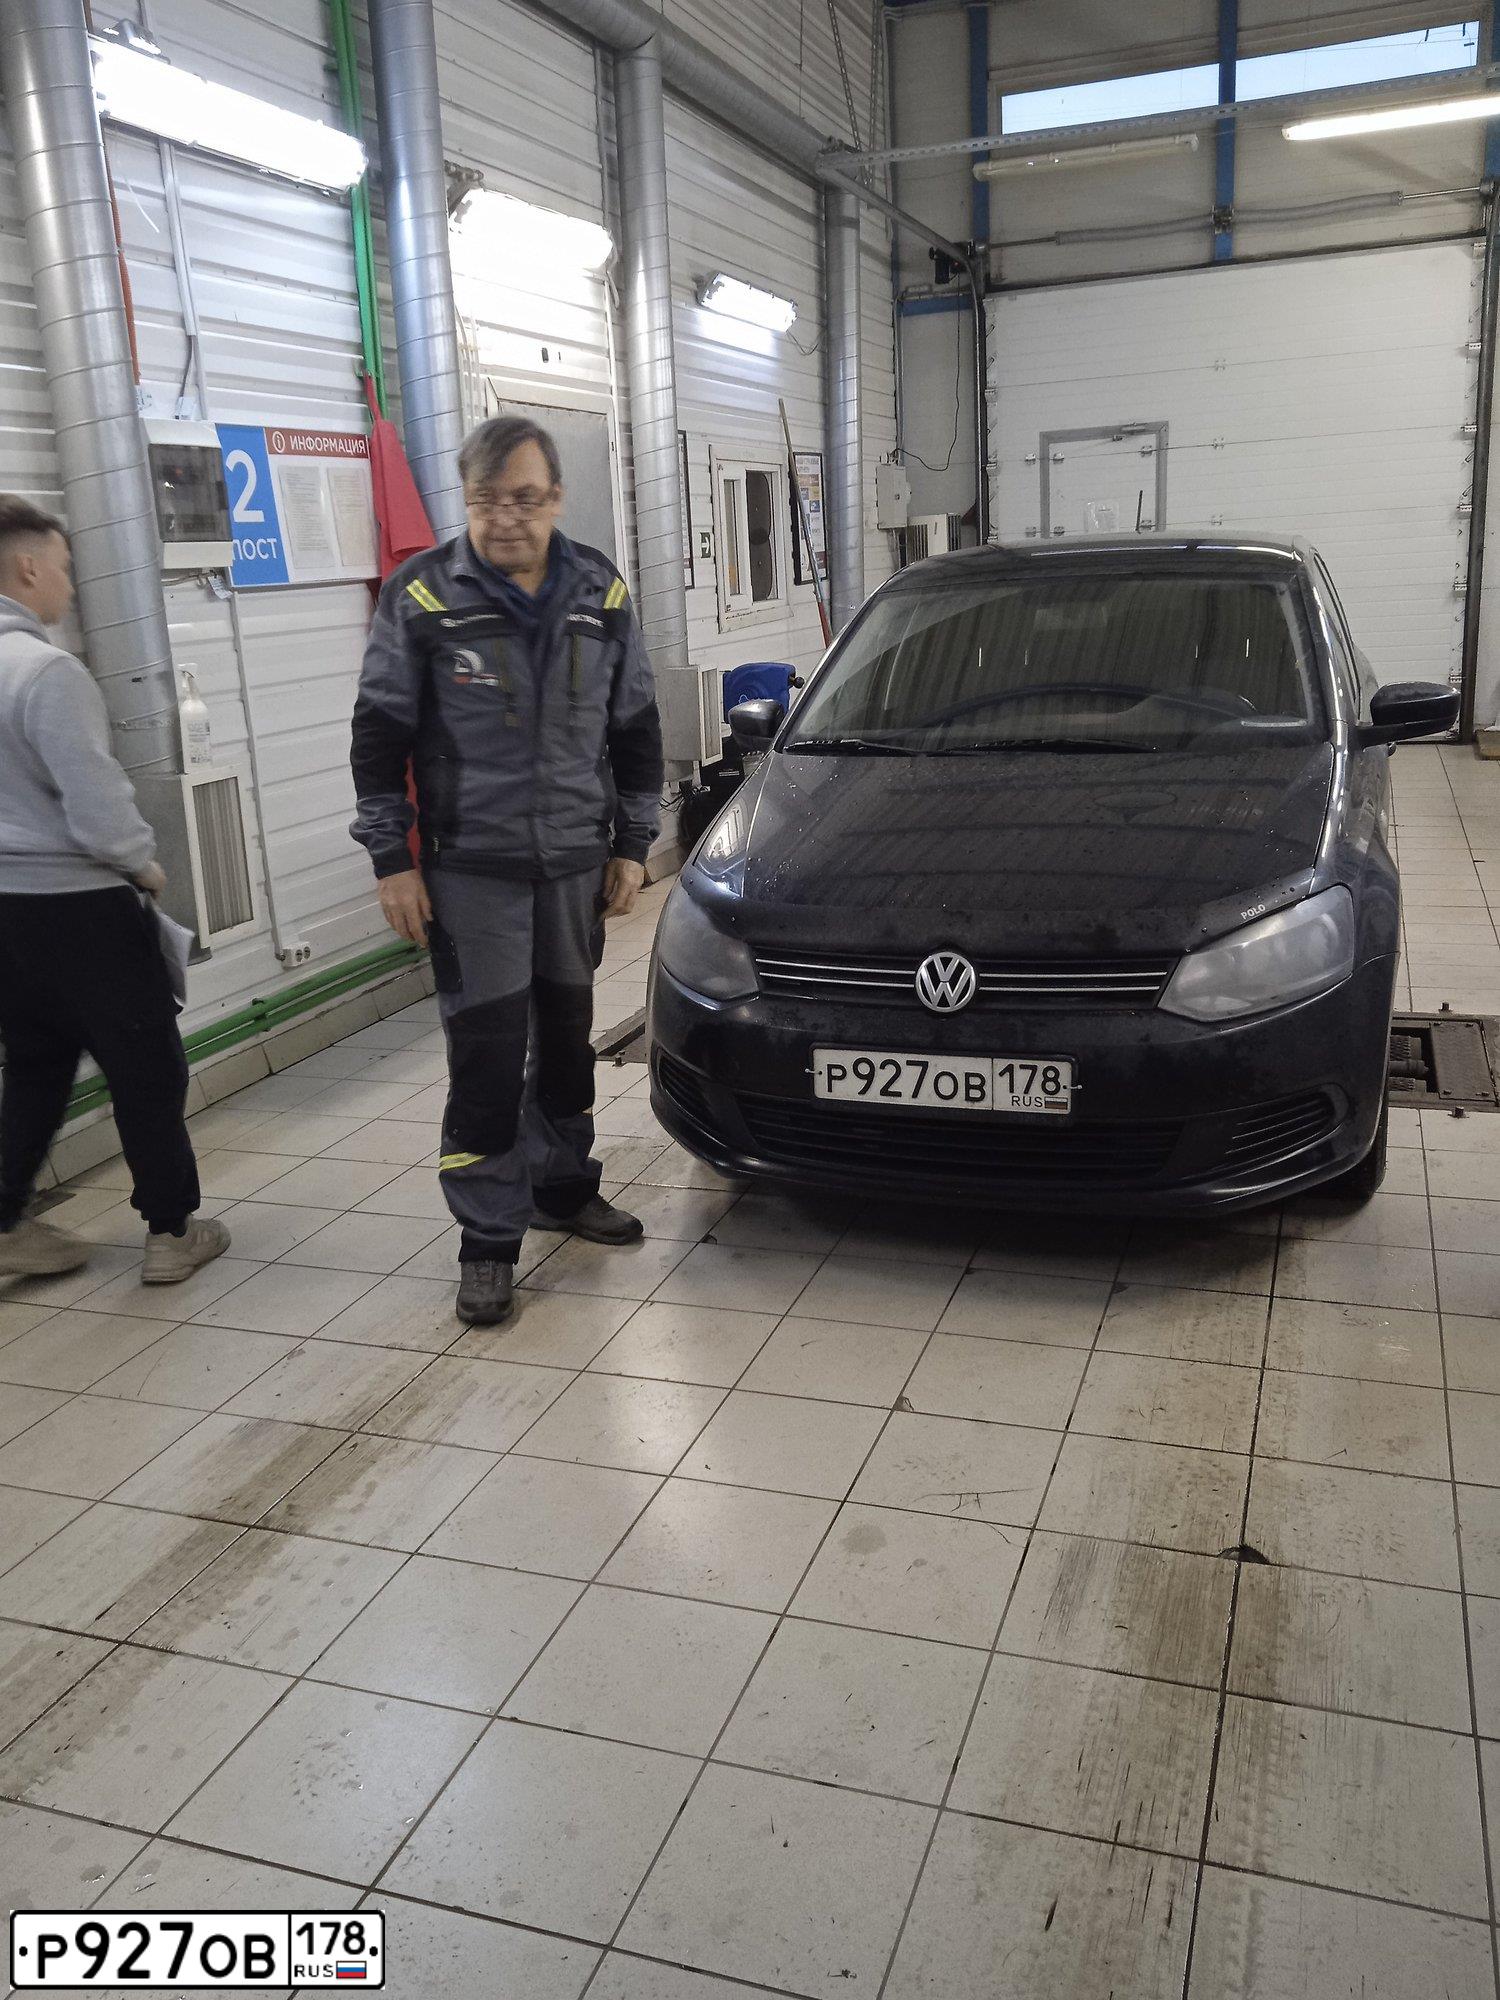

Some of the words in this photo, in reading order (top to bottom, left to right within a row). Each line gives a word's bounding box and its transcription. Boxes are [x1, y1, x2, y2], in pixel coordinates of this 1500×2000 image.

[289, 435, 366, 455] ИНФОРМАЦИЯ
[225, 449, 265, 523] 2
[1240, 904, 1266, 920] POLO
[826, 1057, 987, 1102] Р927ОВ
[998, 1063, 1061, 1096] 178
[1011, 1095, 1043, 1108] RUS
